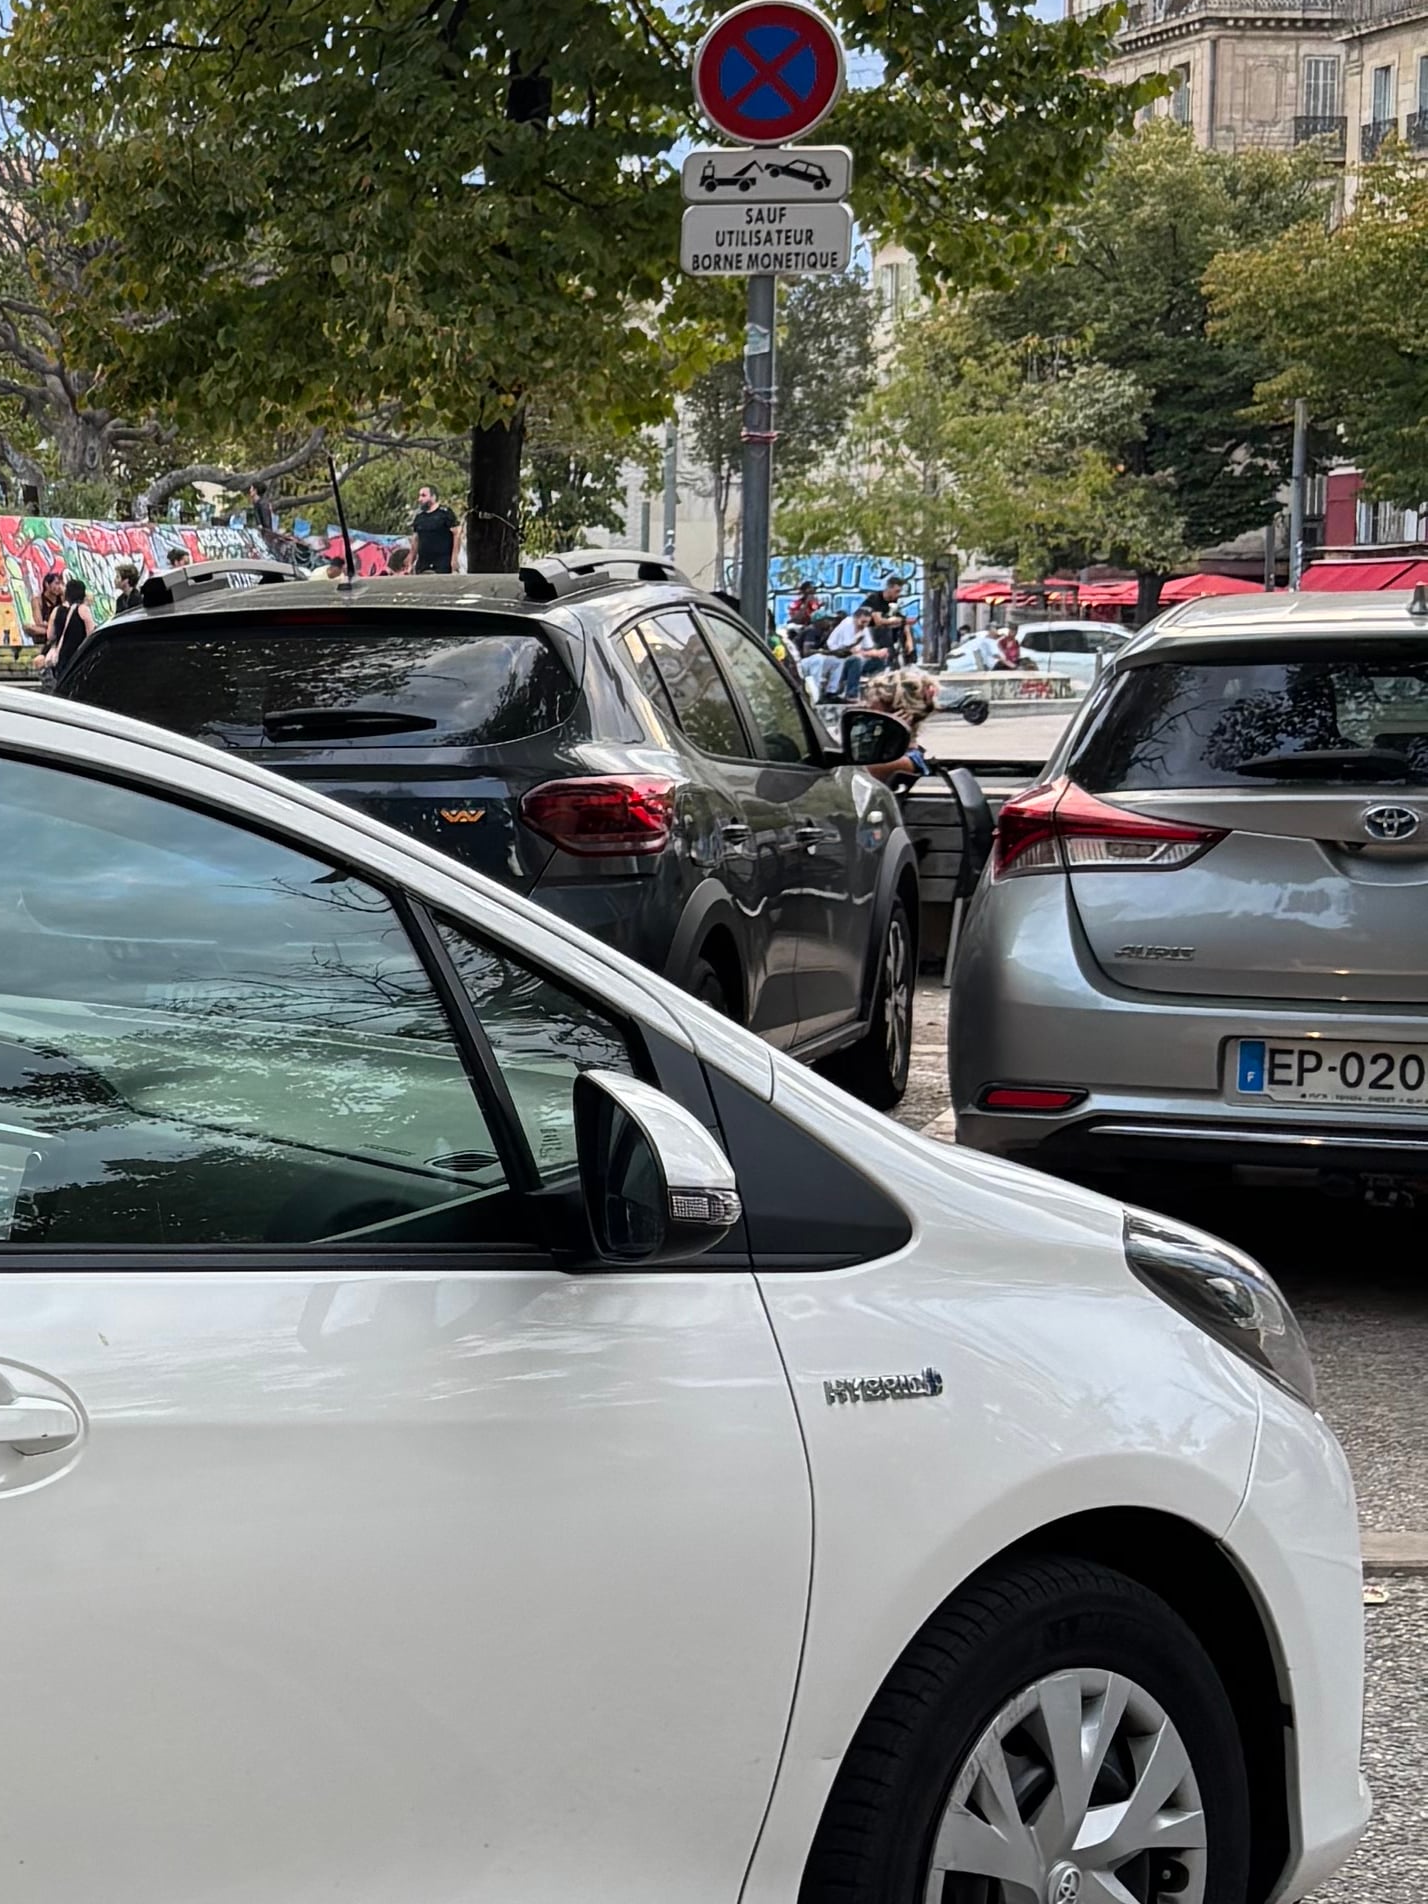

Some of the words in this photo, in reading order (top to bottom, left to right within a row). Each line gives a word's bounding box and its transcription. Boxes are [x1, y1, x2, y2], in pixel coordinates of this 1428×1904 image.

[745, 207, 787, 224] SAUF
[715, 229, 814, 247] UTILISATEUR
[692, 253, 743, 271] BORNE
[746, 251, 838, 271] MONETIQUE
[1267, 1047, 1426, 1091] EP-020
